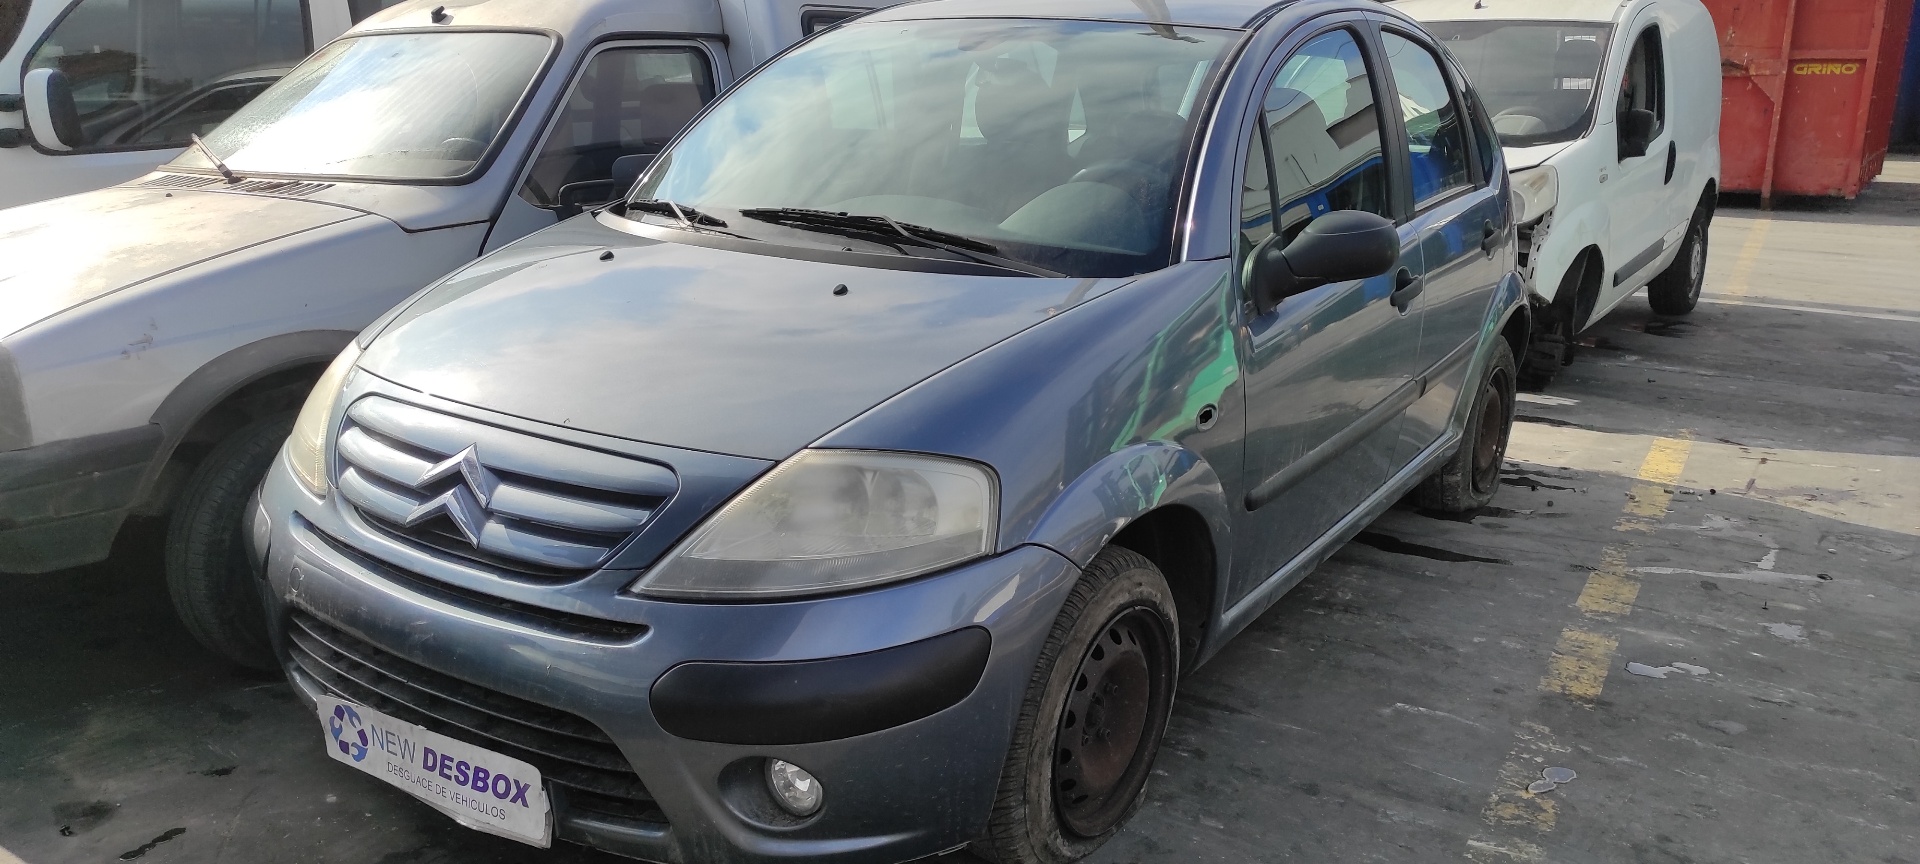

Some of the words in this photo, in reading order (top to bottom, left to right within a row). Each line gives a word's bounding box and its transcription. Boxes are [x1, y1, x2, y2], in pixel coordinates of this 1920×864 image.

[371, 724, 416, 763] NEW
[422, 746, 532, 808] DESBOX
[387, 761, 433, 792] DESGUACE
[435, 783, 447, 799] DE
[449, 789, 506, 820] VEHICULOS
